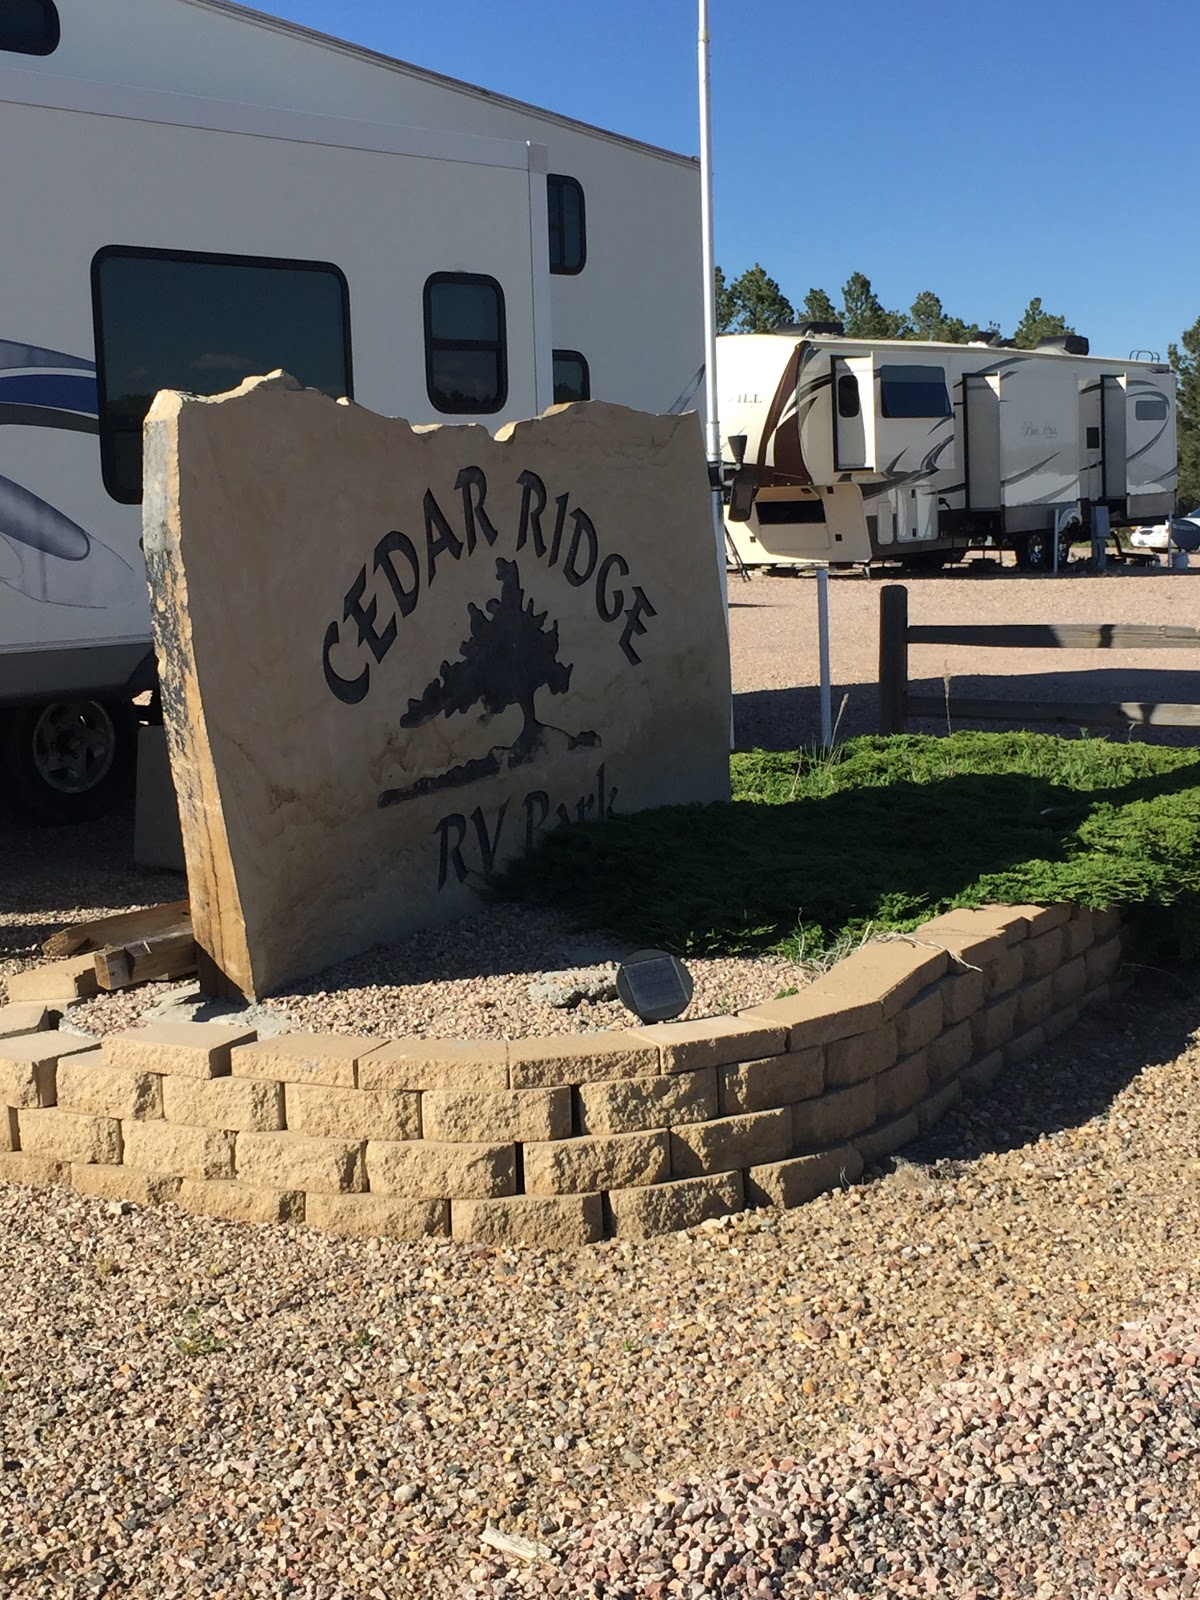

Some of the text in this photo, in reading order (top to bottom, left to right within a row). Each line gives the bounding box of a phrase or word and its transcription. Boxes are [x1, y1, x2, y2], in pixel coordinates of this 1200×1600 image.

[322, 465, 657, 705] CEDAR RIDGE
[433, 796, 511, 893] RV
